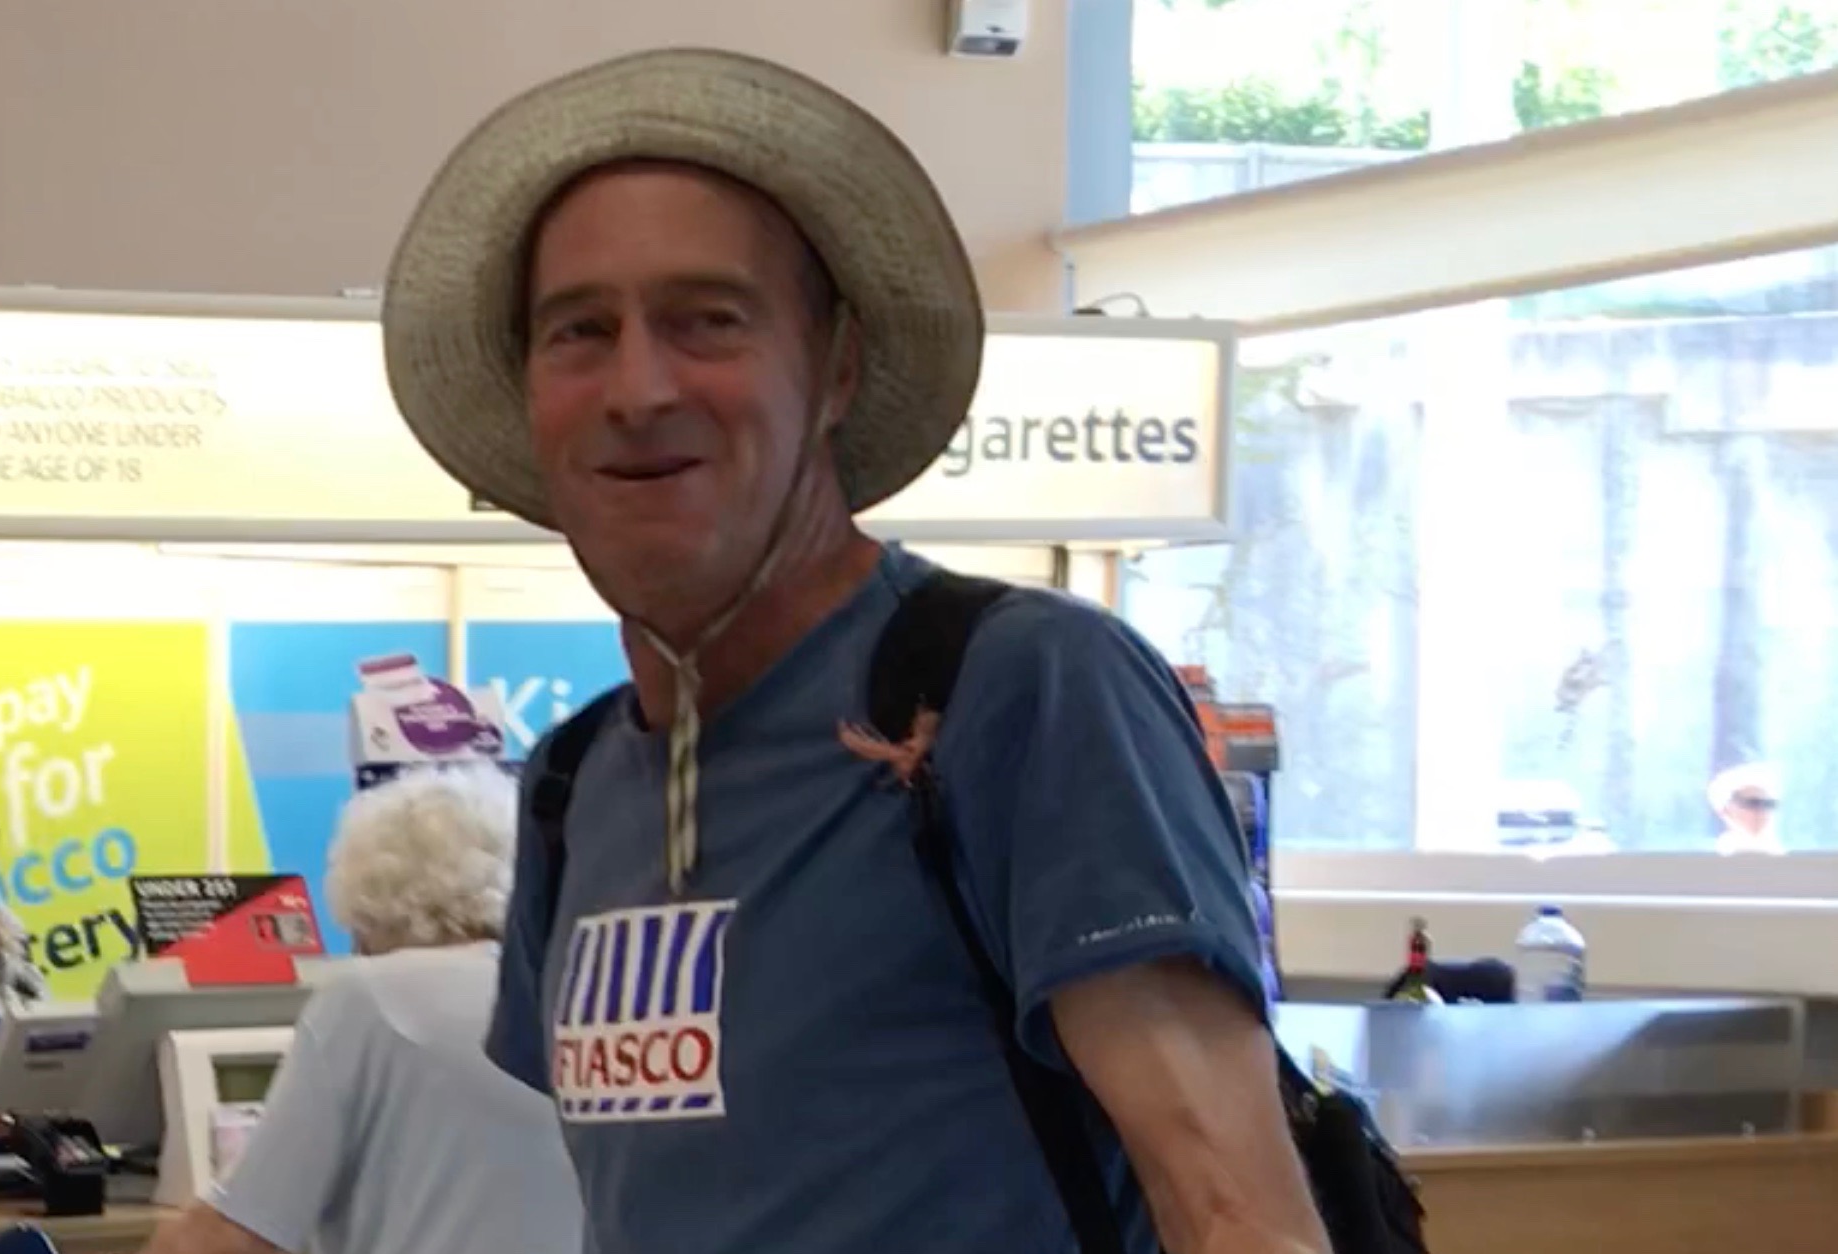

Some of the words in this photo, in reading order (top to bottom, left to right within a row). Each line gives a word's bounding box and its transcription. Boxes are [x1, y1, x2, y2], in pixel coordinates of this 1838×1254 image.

[9, 419, 107, 447] ANYONE
[114, 421, 202, 449] UNDER
[20, 454, 69, 482] AGE
[74, 454, 110, 482] OF
[5, 740, 114, 848] for
[552, 1026, 714, 1088] FIASCO
